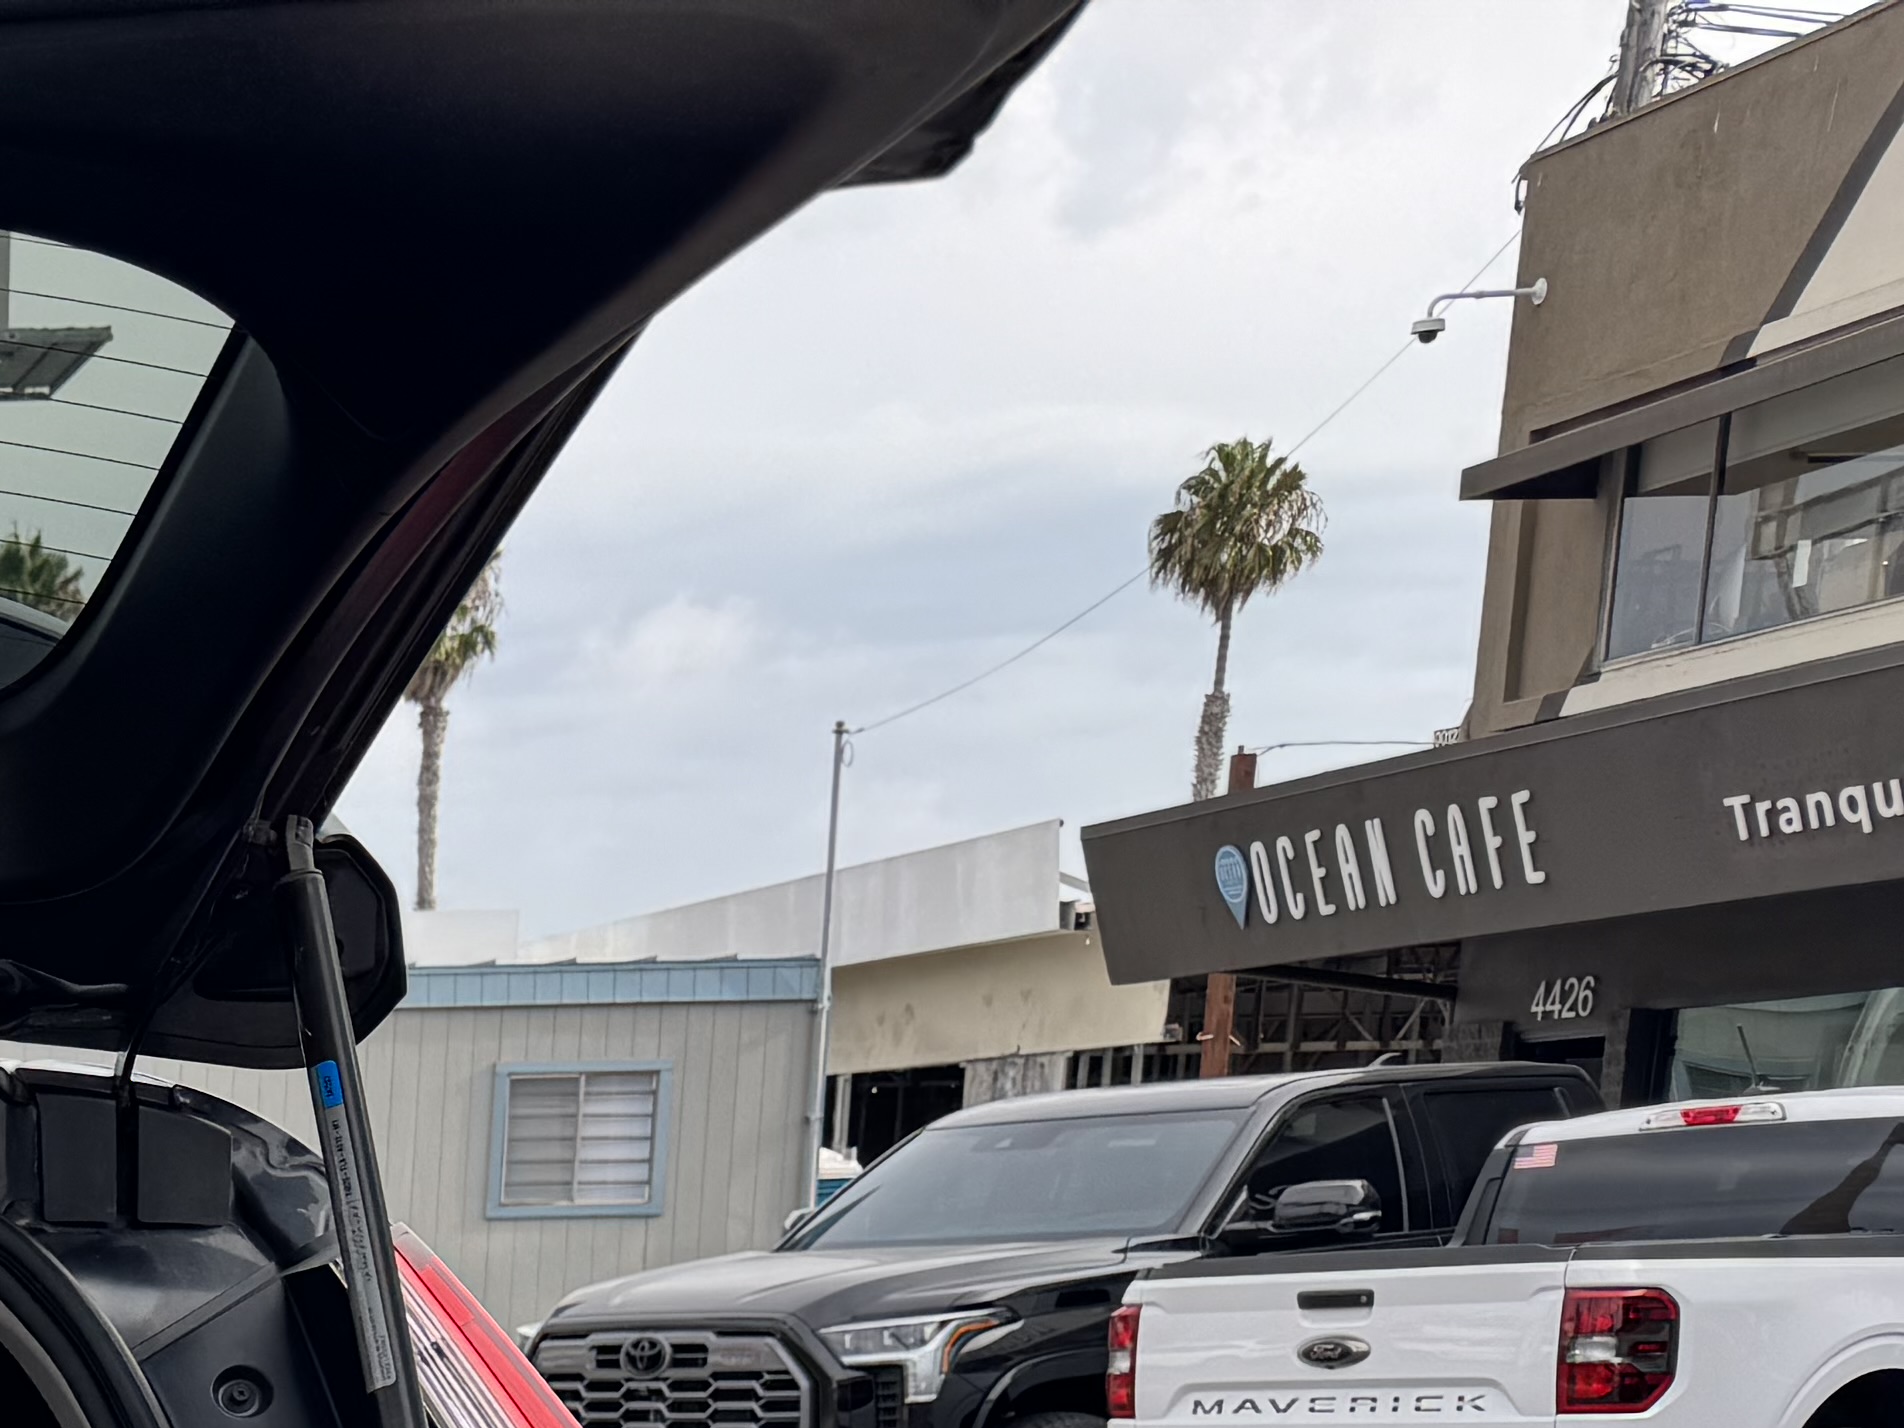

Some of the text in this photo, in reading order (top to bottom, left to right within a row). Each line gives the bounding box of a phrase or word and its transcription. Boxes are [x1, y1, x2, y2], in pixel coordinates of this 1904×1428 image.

[1250, 789, 1546, 924] OCEAN CAFE
[1530, 975, 1595, 1021] 4426
[1191, 1394, 1487, 1415] MAVERICK
